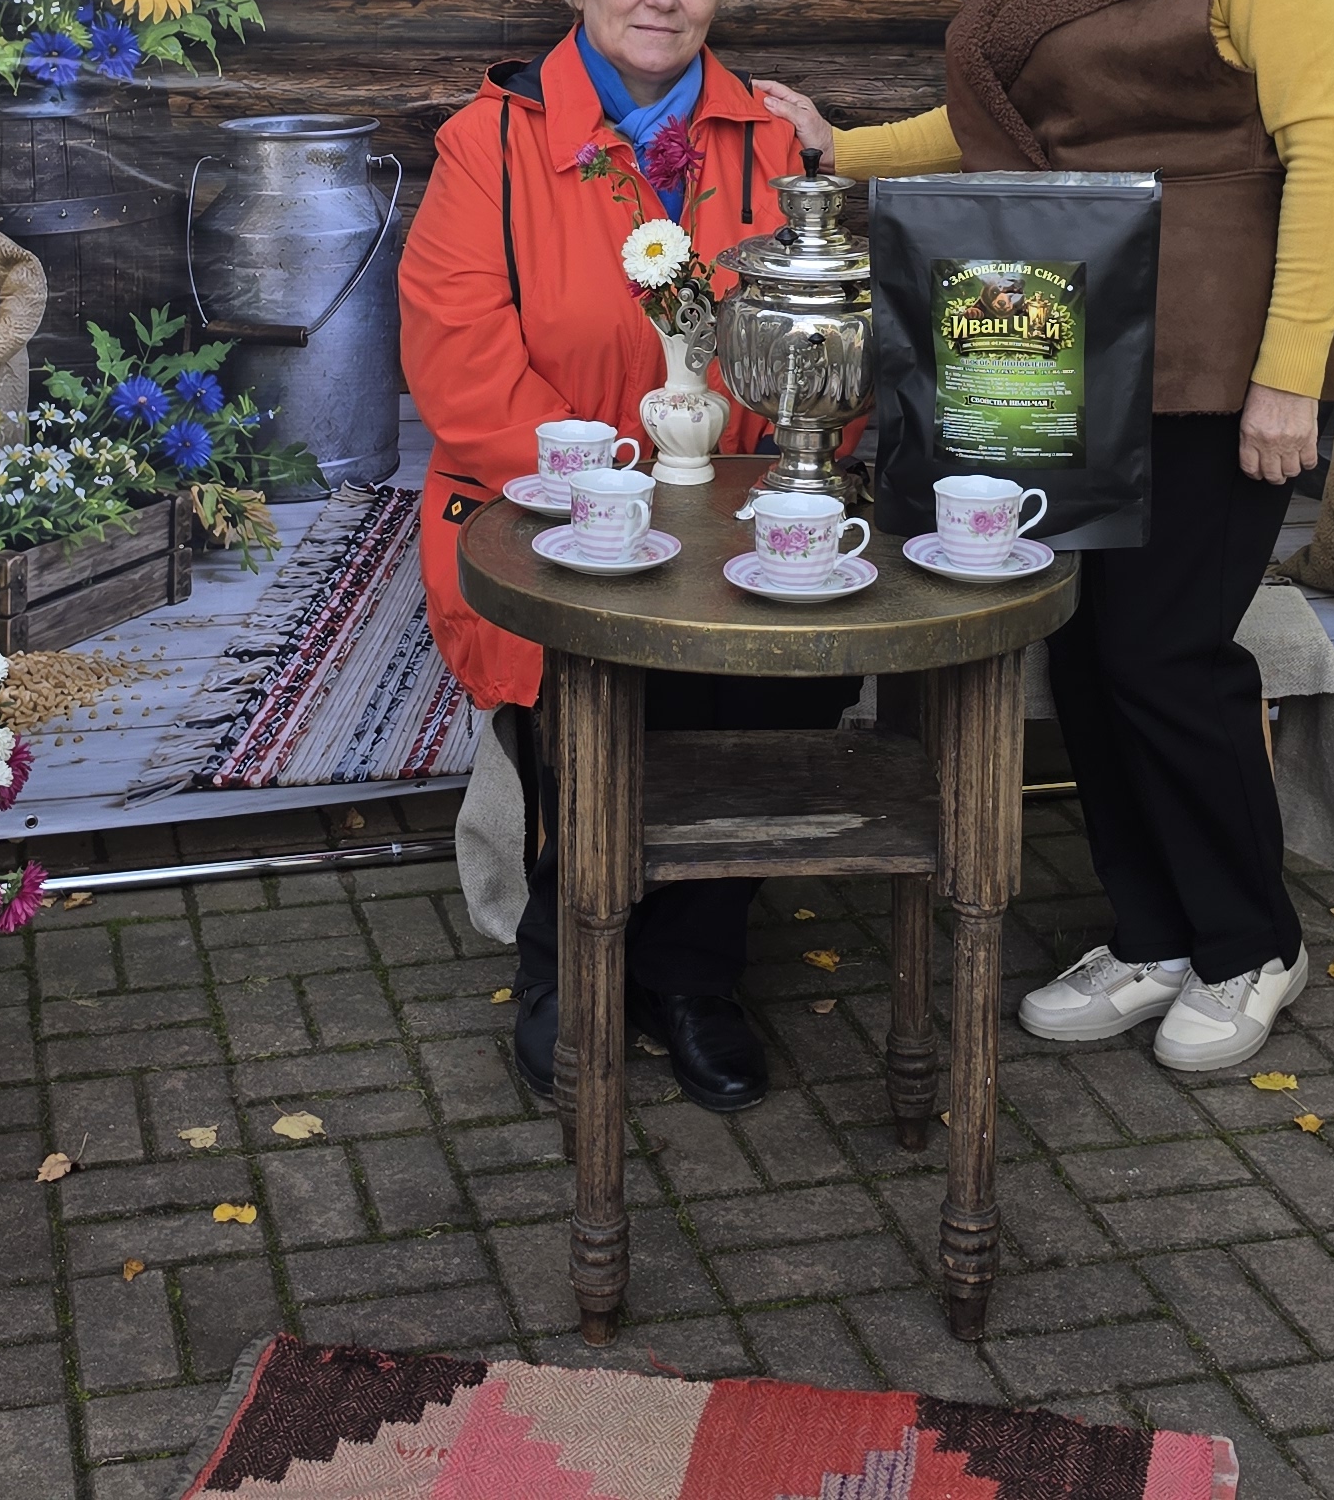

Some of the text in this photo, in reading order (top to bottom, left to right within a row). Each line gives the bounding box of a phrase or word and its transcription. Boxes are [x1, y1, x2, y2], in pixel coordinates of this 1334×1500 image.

[949, 263, 1068, 289] ЗАПОВЕДНАЯ СИЛА
[950, 315, 1008, 339] Иван
